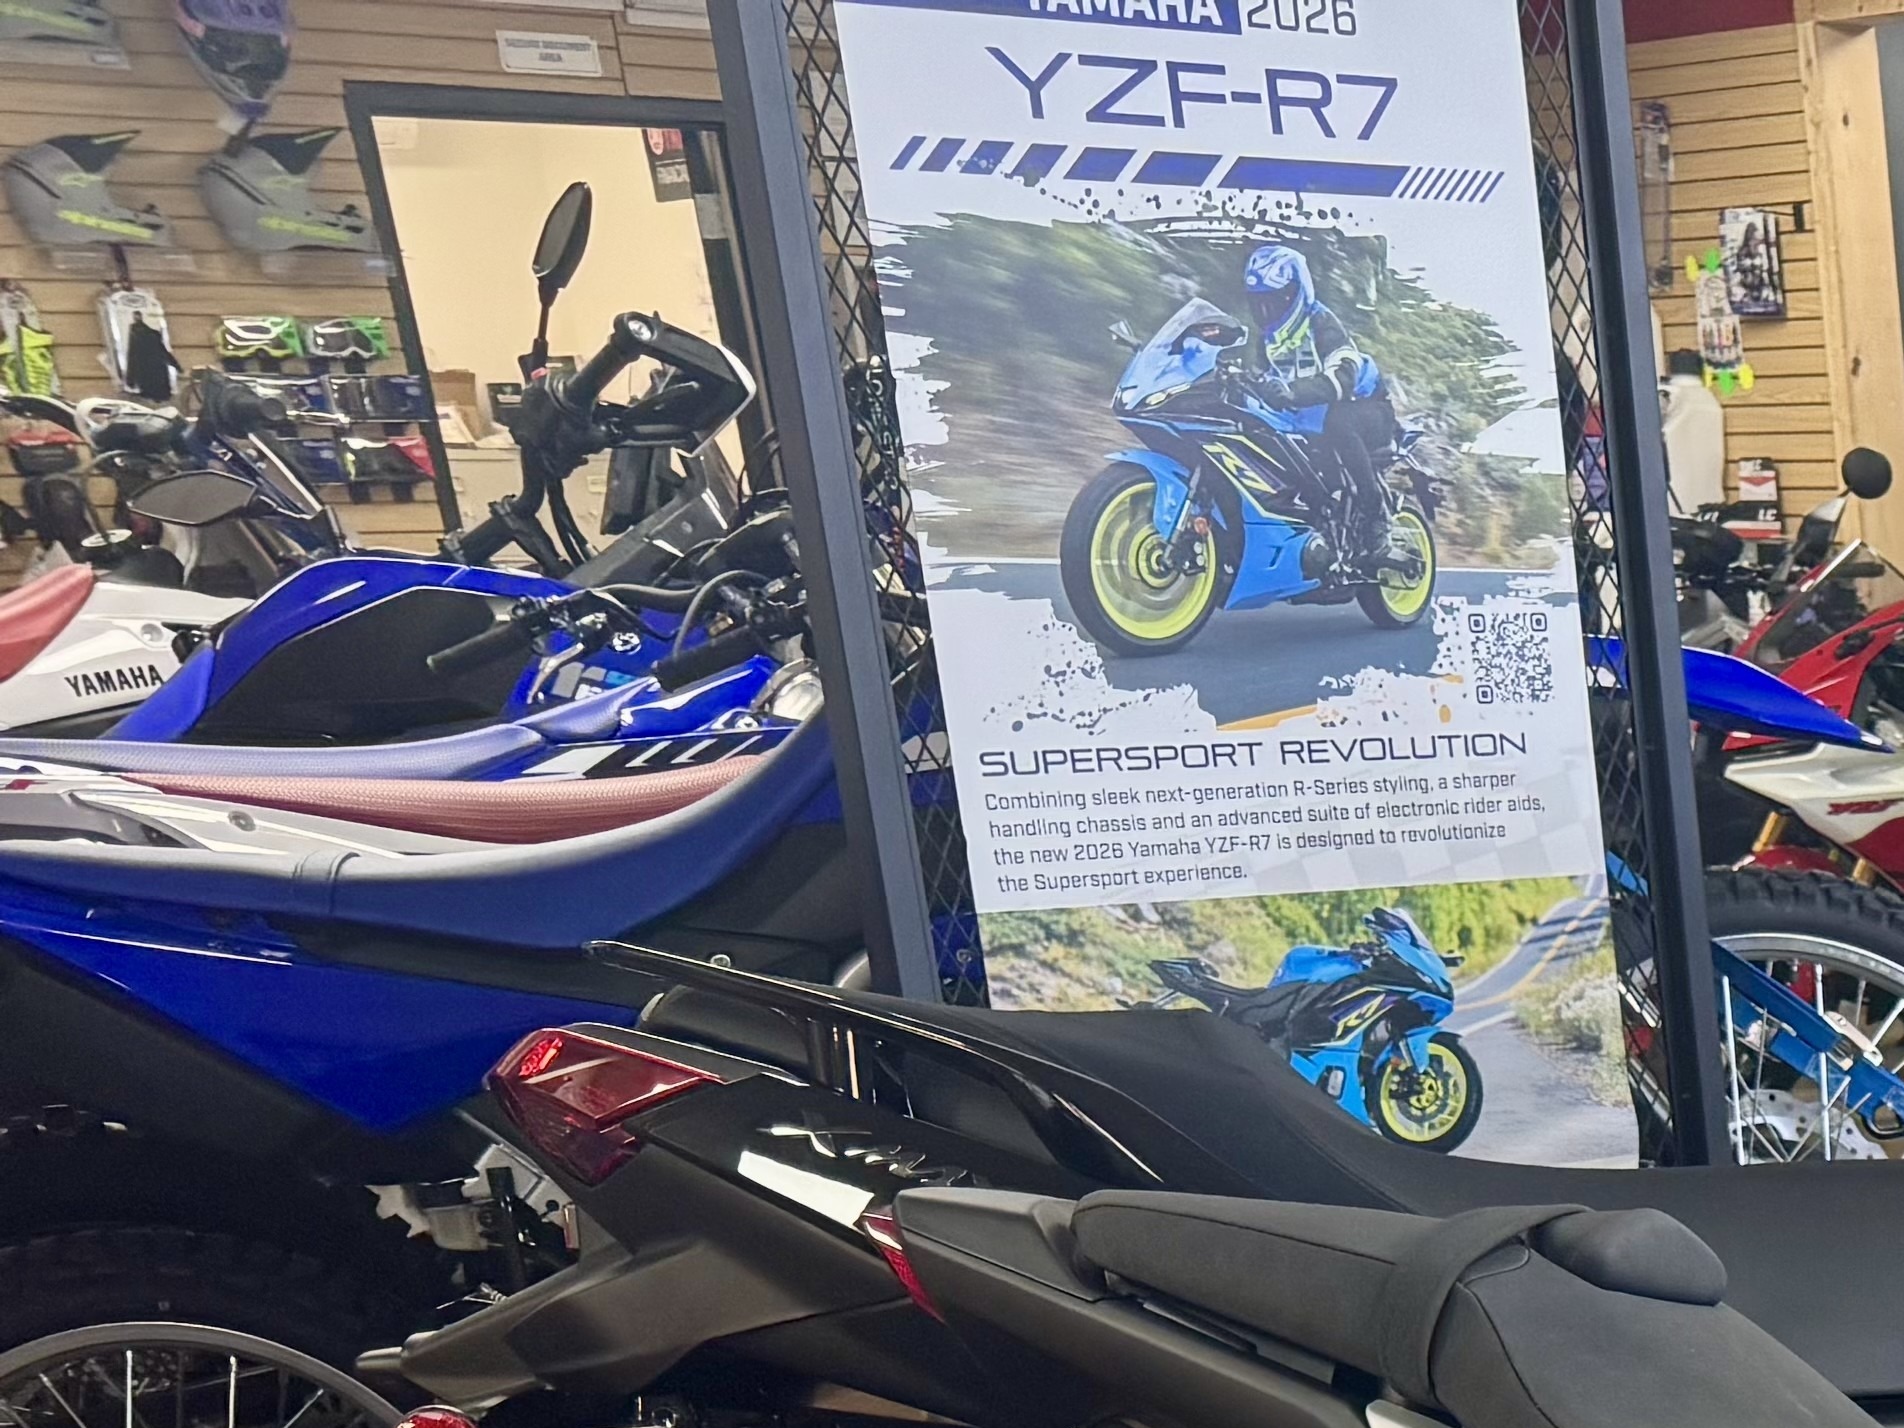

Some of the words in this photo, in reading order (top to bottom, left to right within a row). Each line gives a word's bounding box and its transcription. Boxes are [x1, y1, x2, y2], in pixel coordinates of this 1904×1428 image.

[1248, 0, 1356, 35] 2026
[984, 46, 1398, 140] YZF-R7
[64, 664, 164, 697] YAMAHA
[979, 742, 1263, 777] SUPERSPORT
[1280, 732, 1527, 765] REVOLUTION
[985, 790, 1086, 811] Combining
[1092, 788, 1140, 806] sleek
[1146, 781, 1288, 804] next-generation
[1294, 778, 1368, 797] R-Series
[1374, 775, 1434, 795] styling,
[1438, 777, 1448, 790] a
[1453, 772, 1516, 791] sharper
[989, 819, 1071, 839] handling
[1077, 815, 1147, 834] chassis
[1152, 812, 1185, 829] and
[1191, 813, 1212, 828] an
[1218, 806, 1302, 826] advanced
[1308, 804, 1349, 822] suite
[1355, 802, 1370, 820] of
[1377, 799, 1460, 818] electronic
[1464, 796, 1501, 814] rider
[1507, 795, 1546, 812] aids,
[994, 847, 1025, 866] the
[1030, 847, 1068, 863] new
[1074, 843, 1124, 861] 2026
[1128, 838, 1200, 858] Yamaha
[1205, 834, 1271, 853] YZF-R7
[1277, 833, 1291, 850] is
[1297, 828, 1375, 850] designed
[1380, 827, 1396, 844] to
[1401, 822, 1506, 842] revolutionize
[997, 875, 1028, 893] the
[1035, 869, 1139, 891] Supersport
[1144, 864, 1248, 885] experience.
